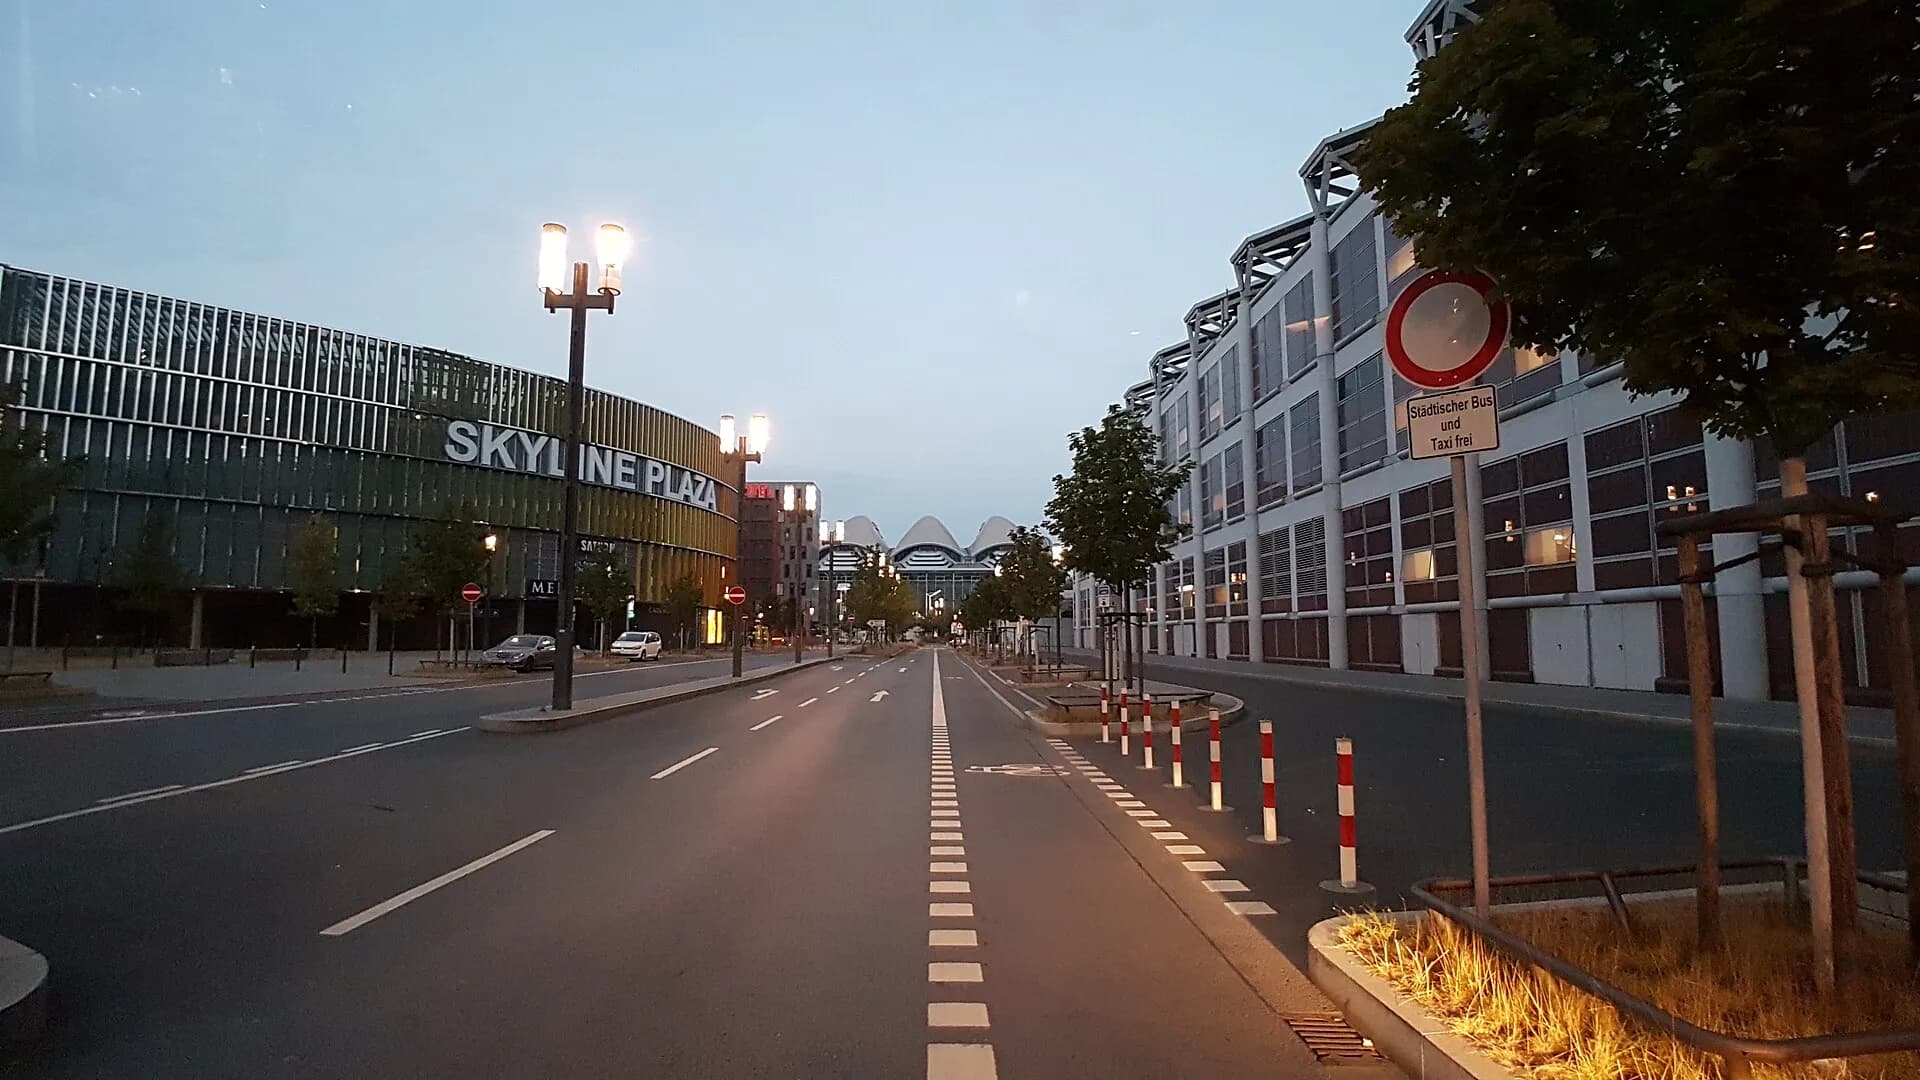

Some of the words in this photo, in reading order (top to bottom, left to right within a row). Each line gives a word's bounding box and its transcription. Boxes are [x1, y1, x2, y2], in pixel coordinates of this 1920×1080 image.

[1411, 400, 1468, 419] Städtischer
[1471, 395, 1493, 409] Bus
[1441, 416, 1461, 432] und
[1430, 435, 1453, 451] Taxi
[1455, 433, 1473, 448] frei
[444, 420, 637, 490] SKYLINE
[645, 459, 718, 511] PLAZA
